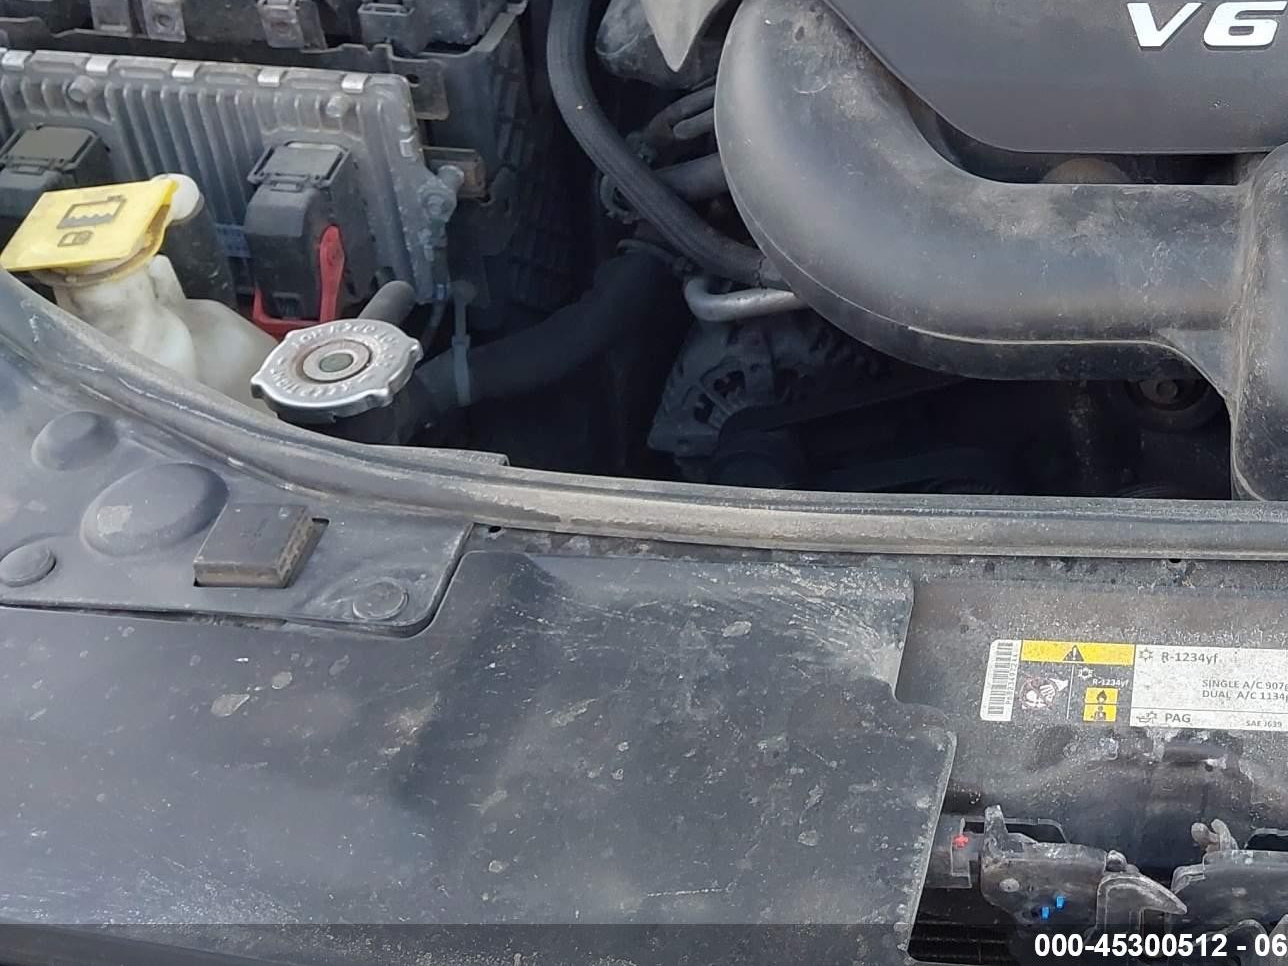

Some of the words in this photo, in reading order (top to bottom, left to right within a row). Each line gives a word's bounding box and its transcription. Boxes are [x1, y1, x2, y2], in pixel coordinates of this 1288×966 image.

[1126, 0, 1288, 50] V6
[1161, 651, 1218, 665] R-1234yf
[1202, 679, 1239, 689] SINGLE
[1243, 680, 1264, 690] A/C
[1202, 690, 1231, 699] DUAL
[1237, 691, 1257, 700] A/C
[1164, 713, 1191, 724] PAG
[1245, 720, 1262, 728] SAE
